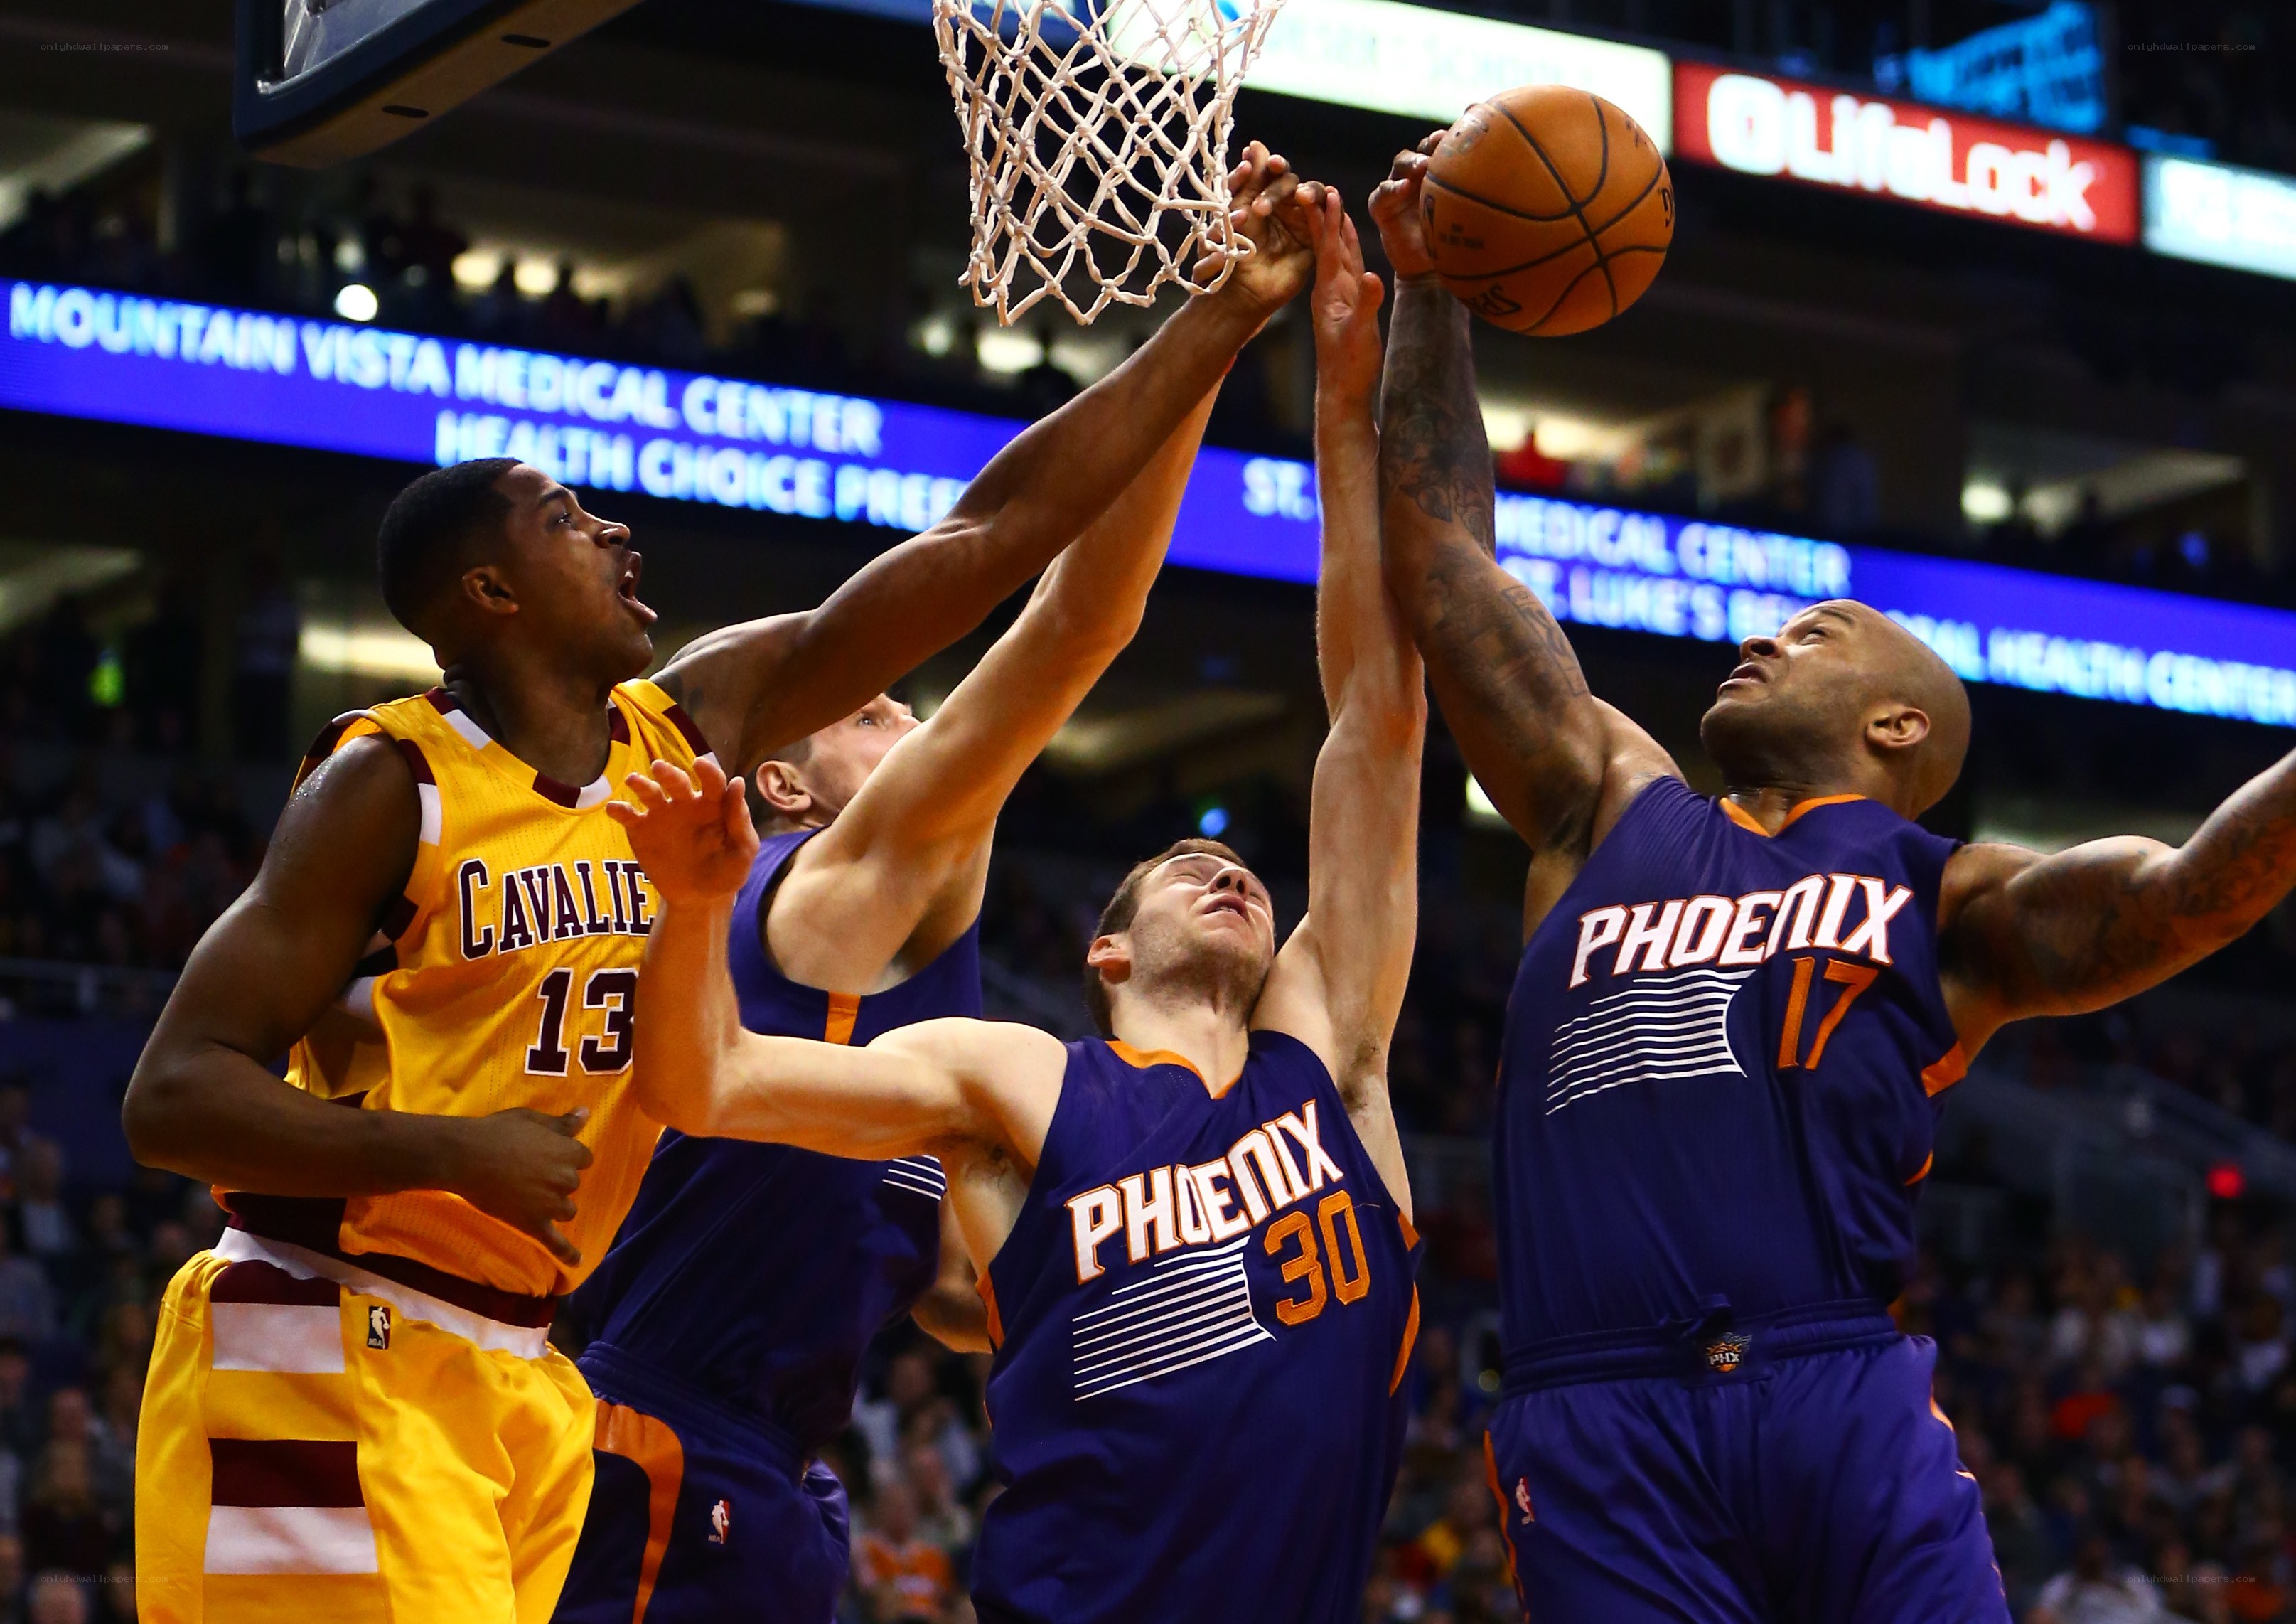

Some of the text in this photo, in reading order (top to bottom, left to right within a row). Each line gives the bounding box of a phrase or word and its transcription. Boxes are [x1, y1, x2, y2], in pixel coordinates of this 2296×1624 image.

[10, 282, 883, 458] MOUNTAIN VISTA MEDICAL CENTER
[434, 410, 635, 492] HEALTH
[639, 437, 832, 519] CHOICE
[1242, 457, 1316, 520] ST.
[1676, 521, 1852, 599] CENTER
[1568, 566, 1727, 641] LUKE'S
[1988, 626, 2147, 705] HEALTH
[458, 858, 658, 961] CAVALIE
[1567, 872, 1914, 989] PHOENIX
[525, 967, 639, 1077] 13
[1777, 956, 1879, 1072] 17
[1064, 1098, 1344, 1286] PHOENIX
[1263, 1190, 1370, 1326] 30
[1708, 1352, 1740, 1365] PHX
